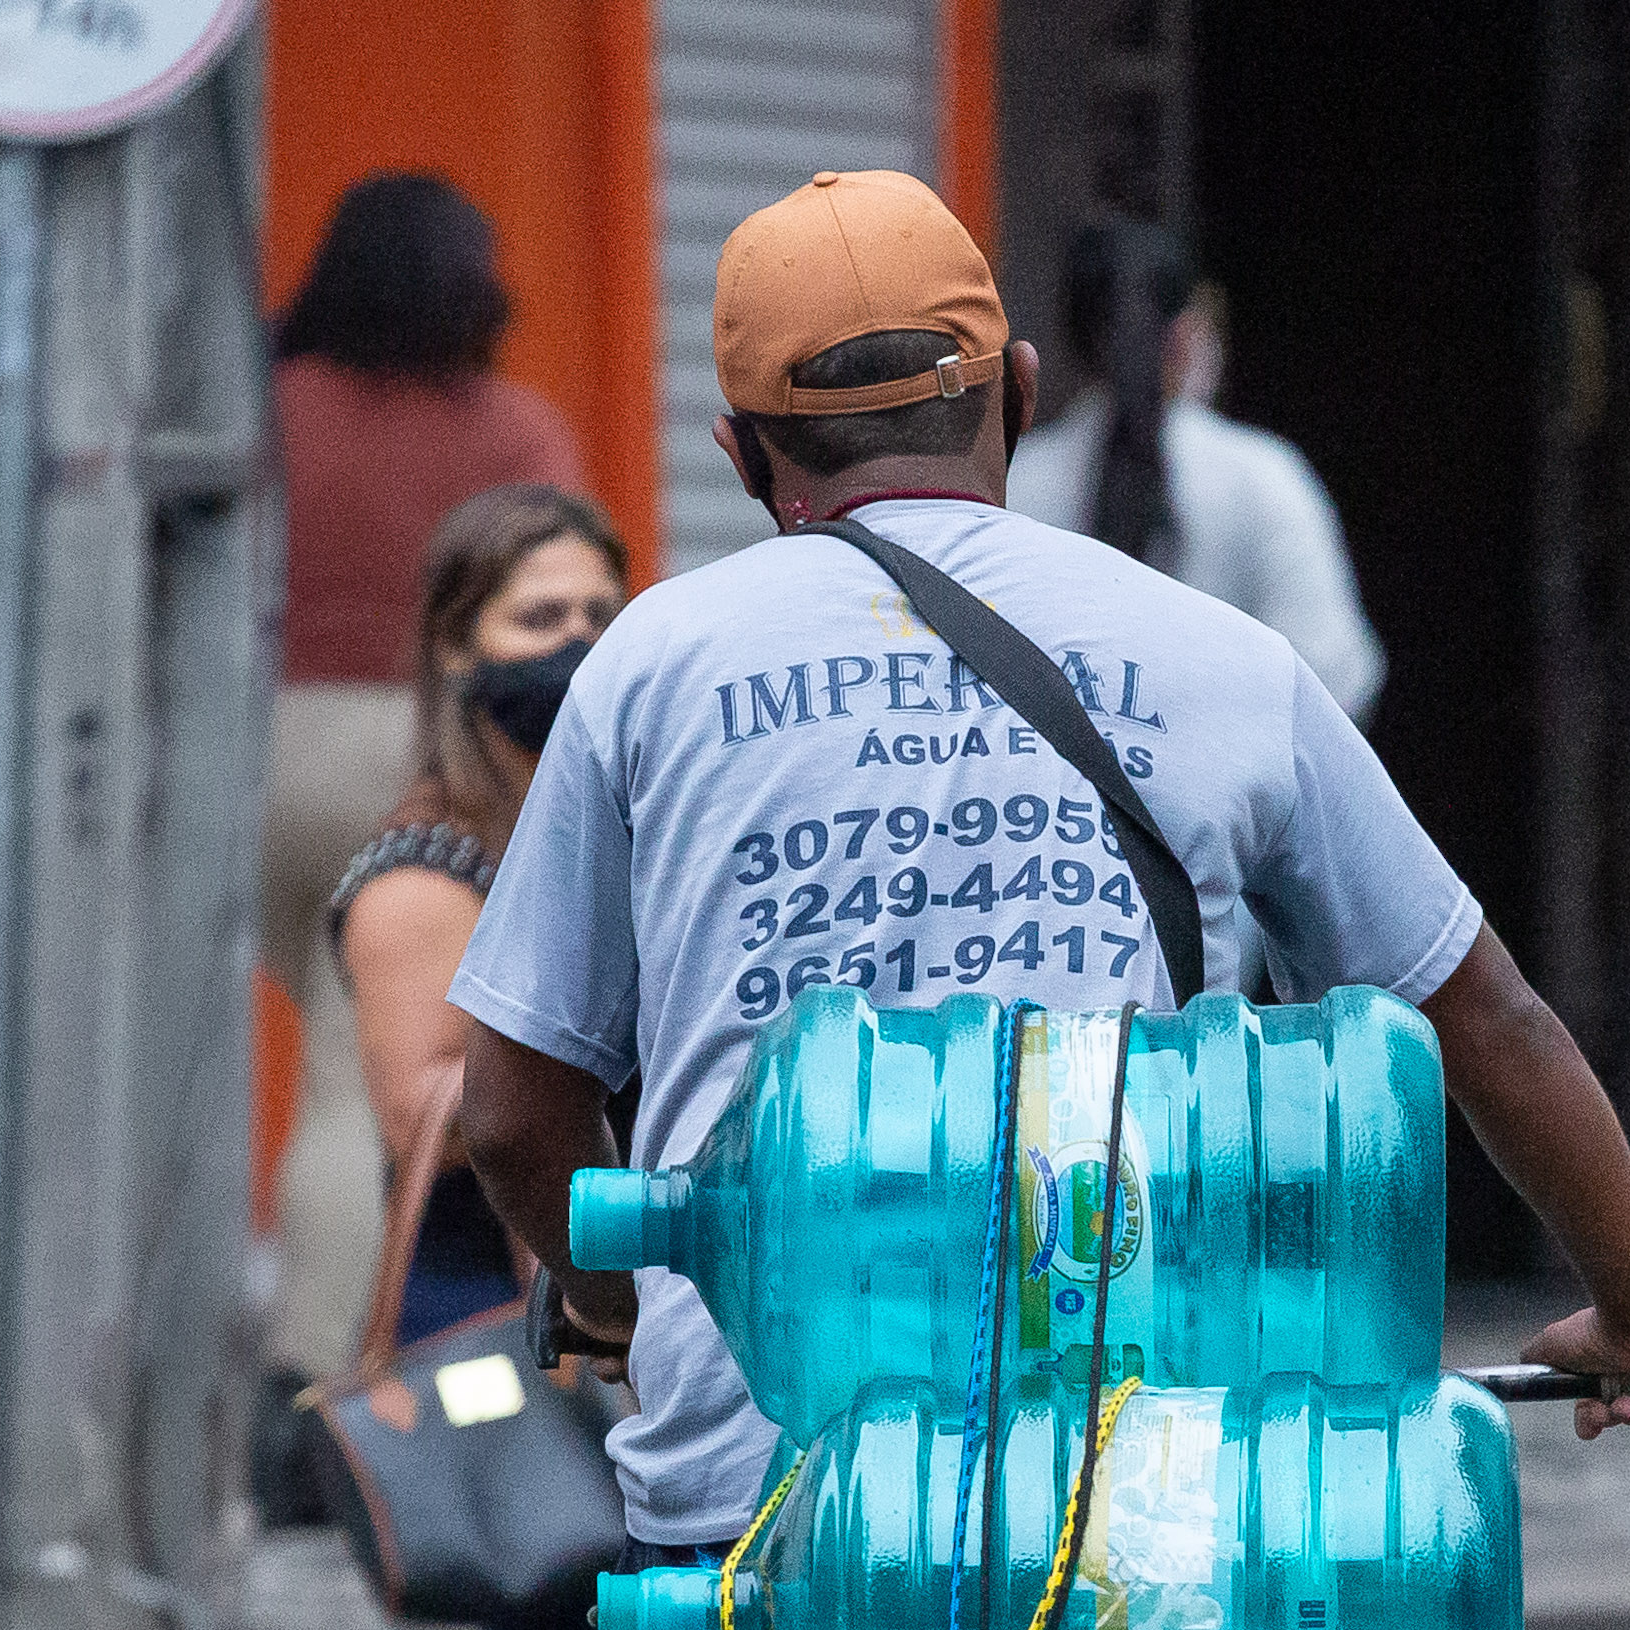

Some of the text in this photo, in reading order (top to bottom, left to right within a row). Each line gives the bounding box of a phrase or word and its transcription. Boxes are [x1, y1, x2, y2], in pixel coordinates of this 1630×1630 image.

[714, 649, 1168, 748] IMPERAL
[855, 726, 1037, 769] ÁGUA E
[739, 854, 1139, 951] 3249-4494
[736, 921, 1140, 1020] 9651-9417
